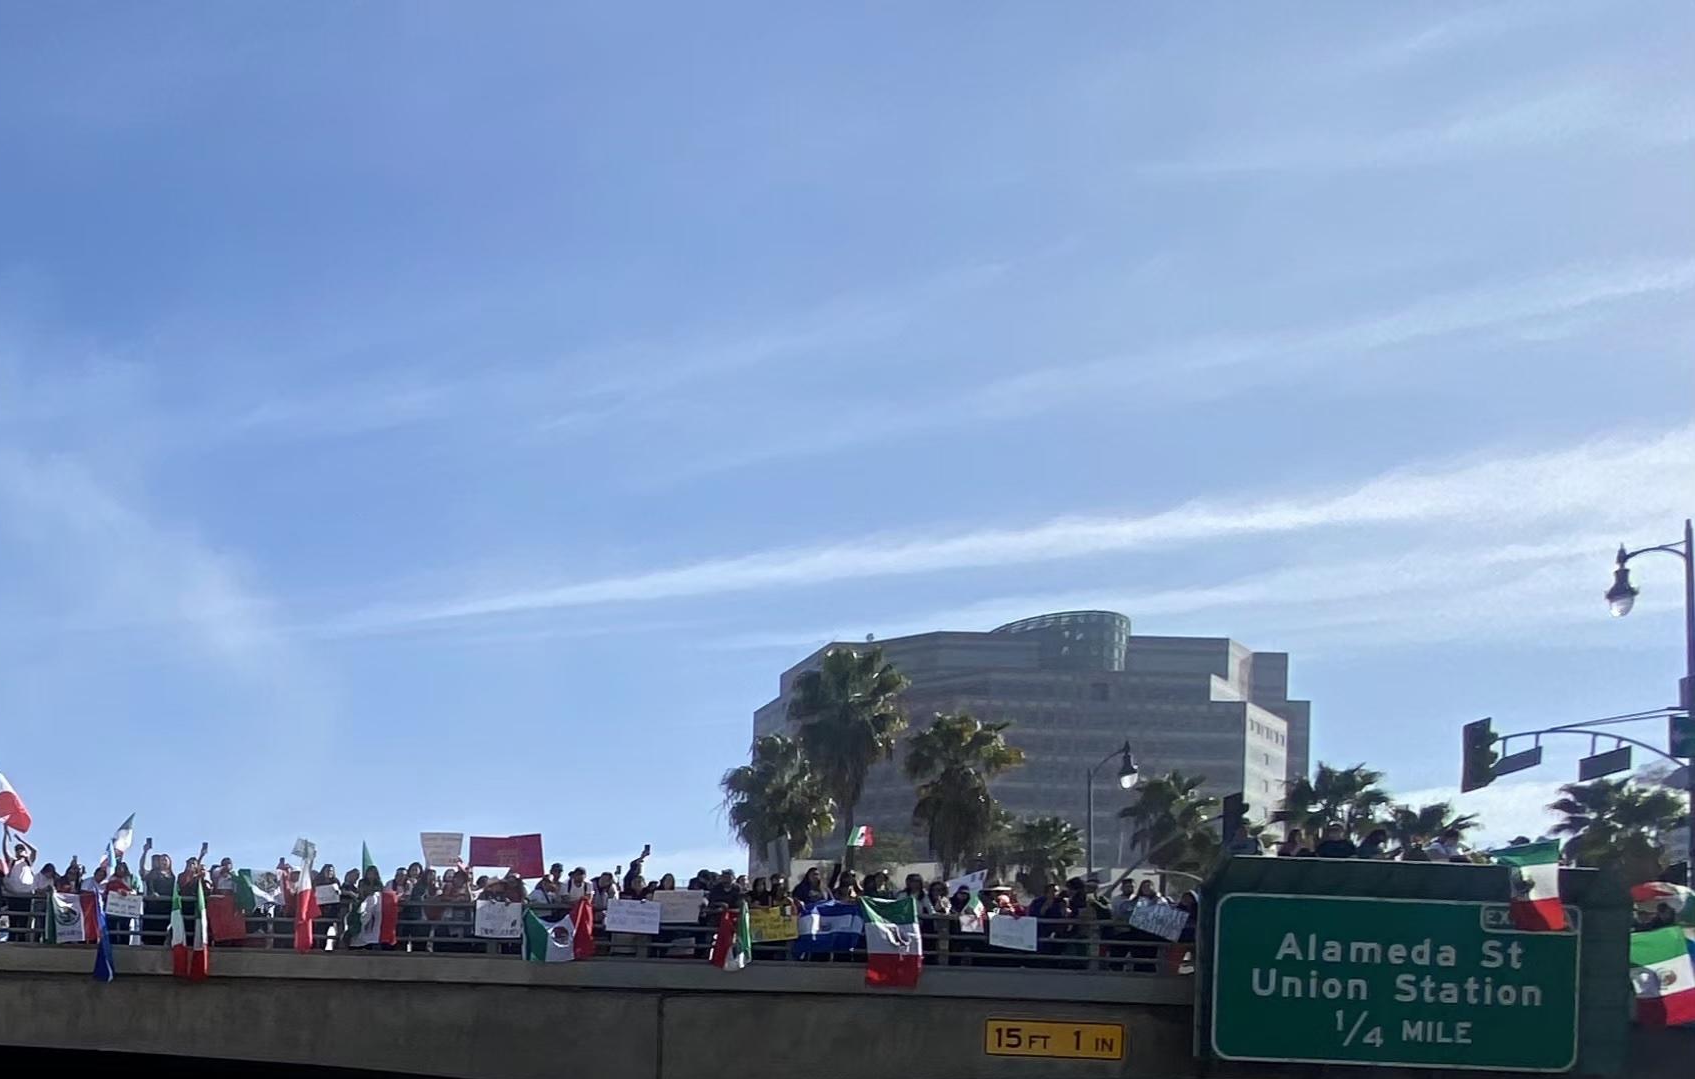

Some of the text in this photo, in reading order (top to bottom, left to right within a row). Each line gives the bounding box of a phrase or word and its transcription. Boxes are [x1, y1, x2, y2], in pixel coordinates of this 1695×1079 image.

[1275, 931, 1524, 969] Alameda St
[1252, 967, 1542, 1007] Union Station
[995, 1027, 1114, 1053] 15 FT 1 IN
[1335, 1009, 1473, 1048] 1/4 MILE
